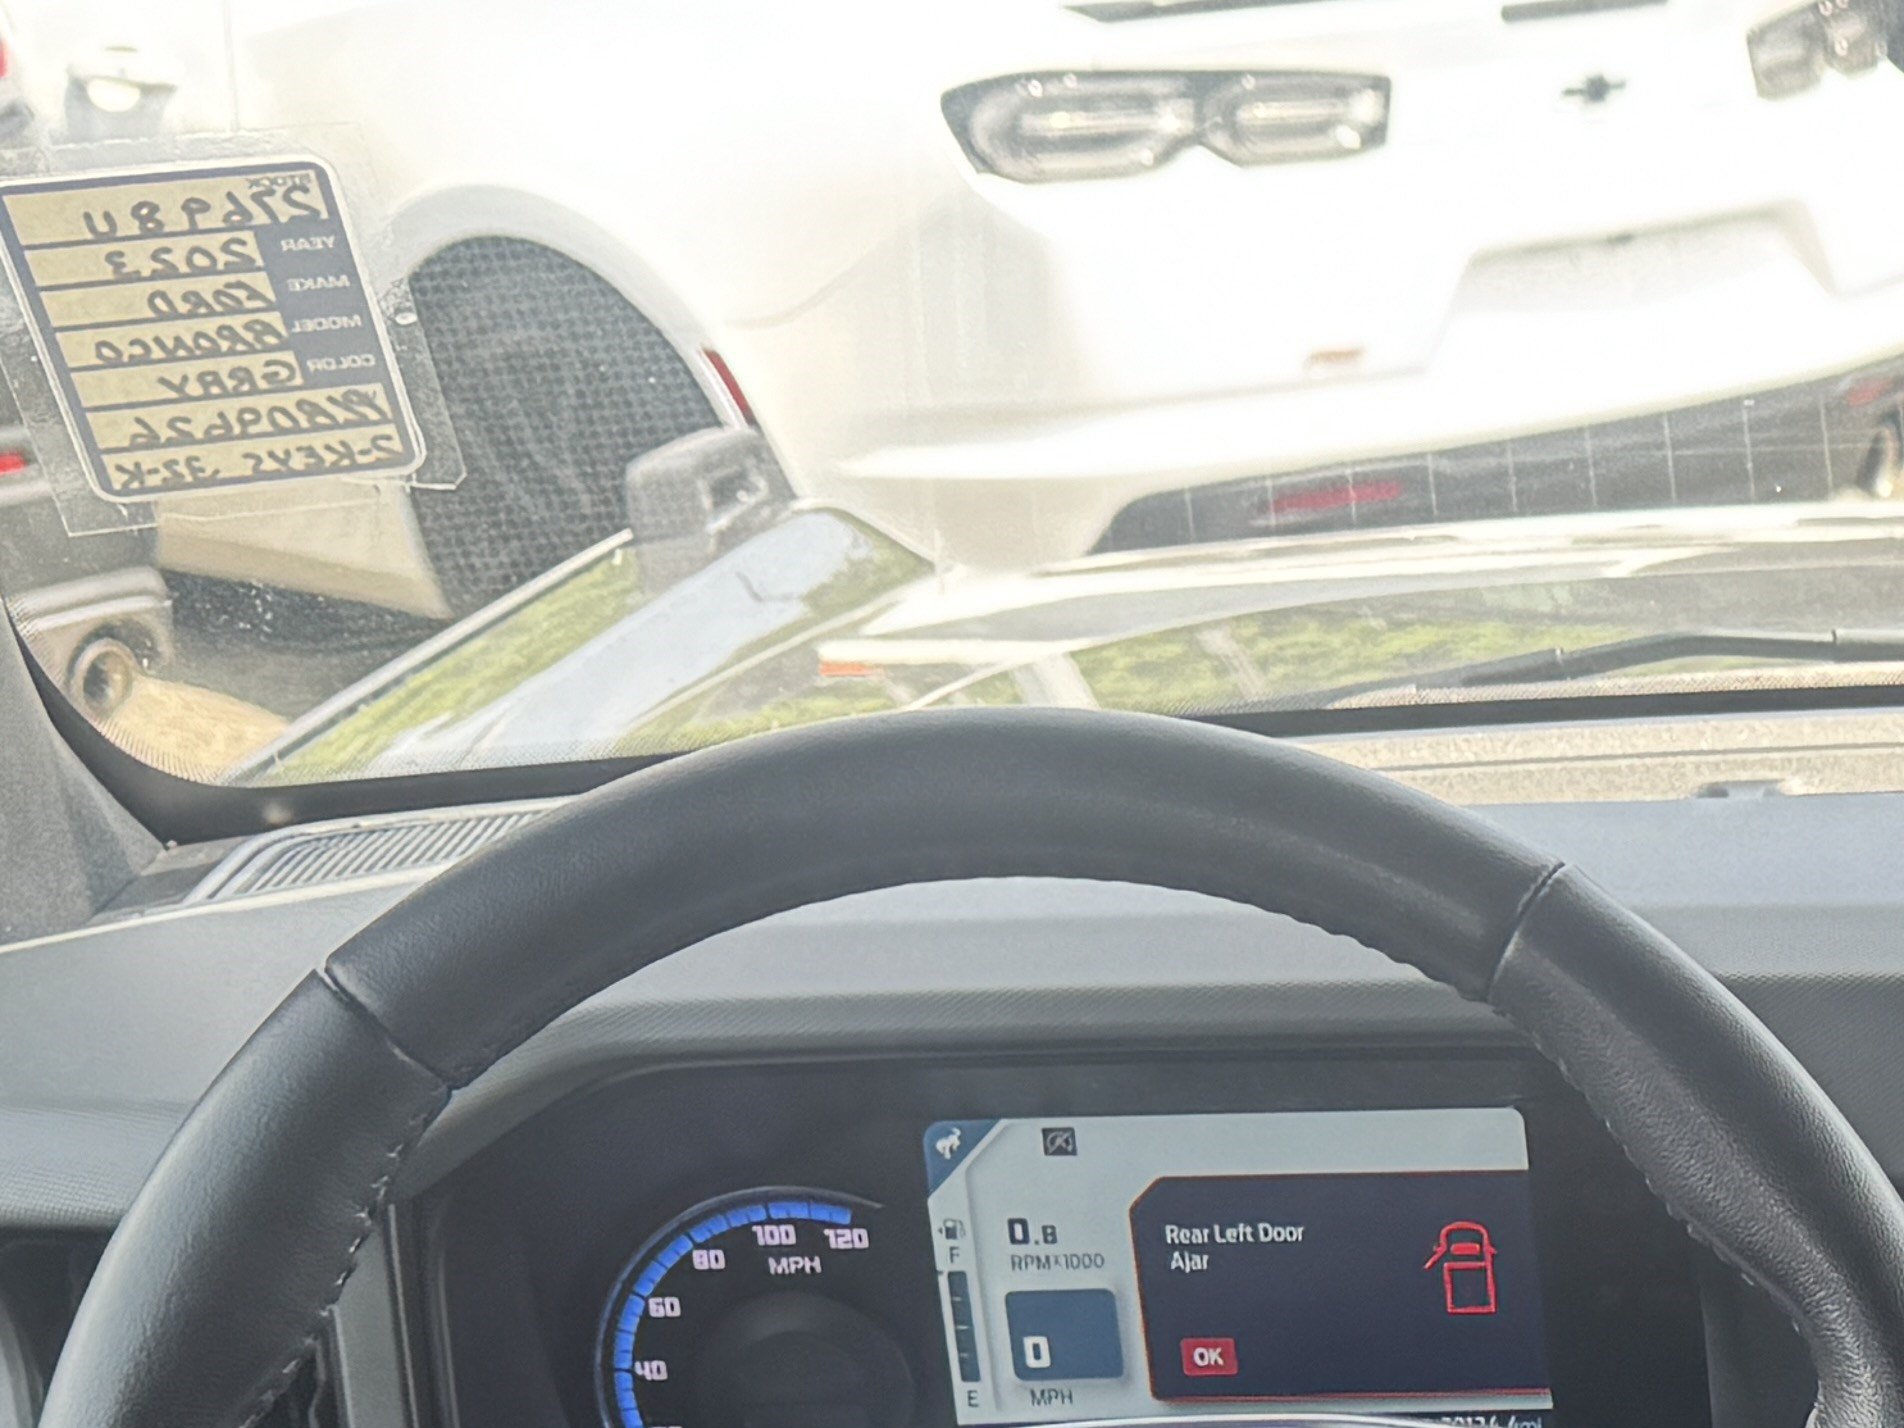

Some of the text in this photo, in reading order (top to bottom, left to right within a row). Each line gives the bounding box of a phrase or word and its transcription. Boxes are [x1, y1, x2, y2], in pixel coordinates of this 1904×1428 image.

[752, 1224, 796, 1246] 100
[824, 1228, 869, 1249] 120
[1165, 1222, 1306, 1244] Rear Left Door
[692, 1249, 726, 1270] 80
[768, 1256, 822, 1275] MPH
[949, 1246, 960, 1264] F
[1170, 1251, 1210, 1273] Ajar
[648, 1296, 681, 1318] 60
[1023, 1336, 1051, 1369] 0
[1193, 1347, 1224, 1366] OK
[634, 1360, 668, 1381] 40
[967, 1390, 980, 1407] E
[1029, 1388, 1074, 1406] MPH
